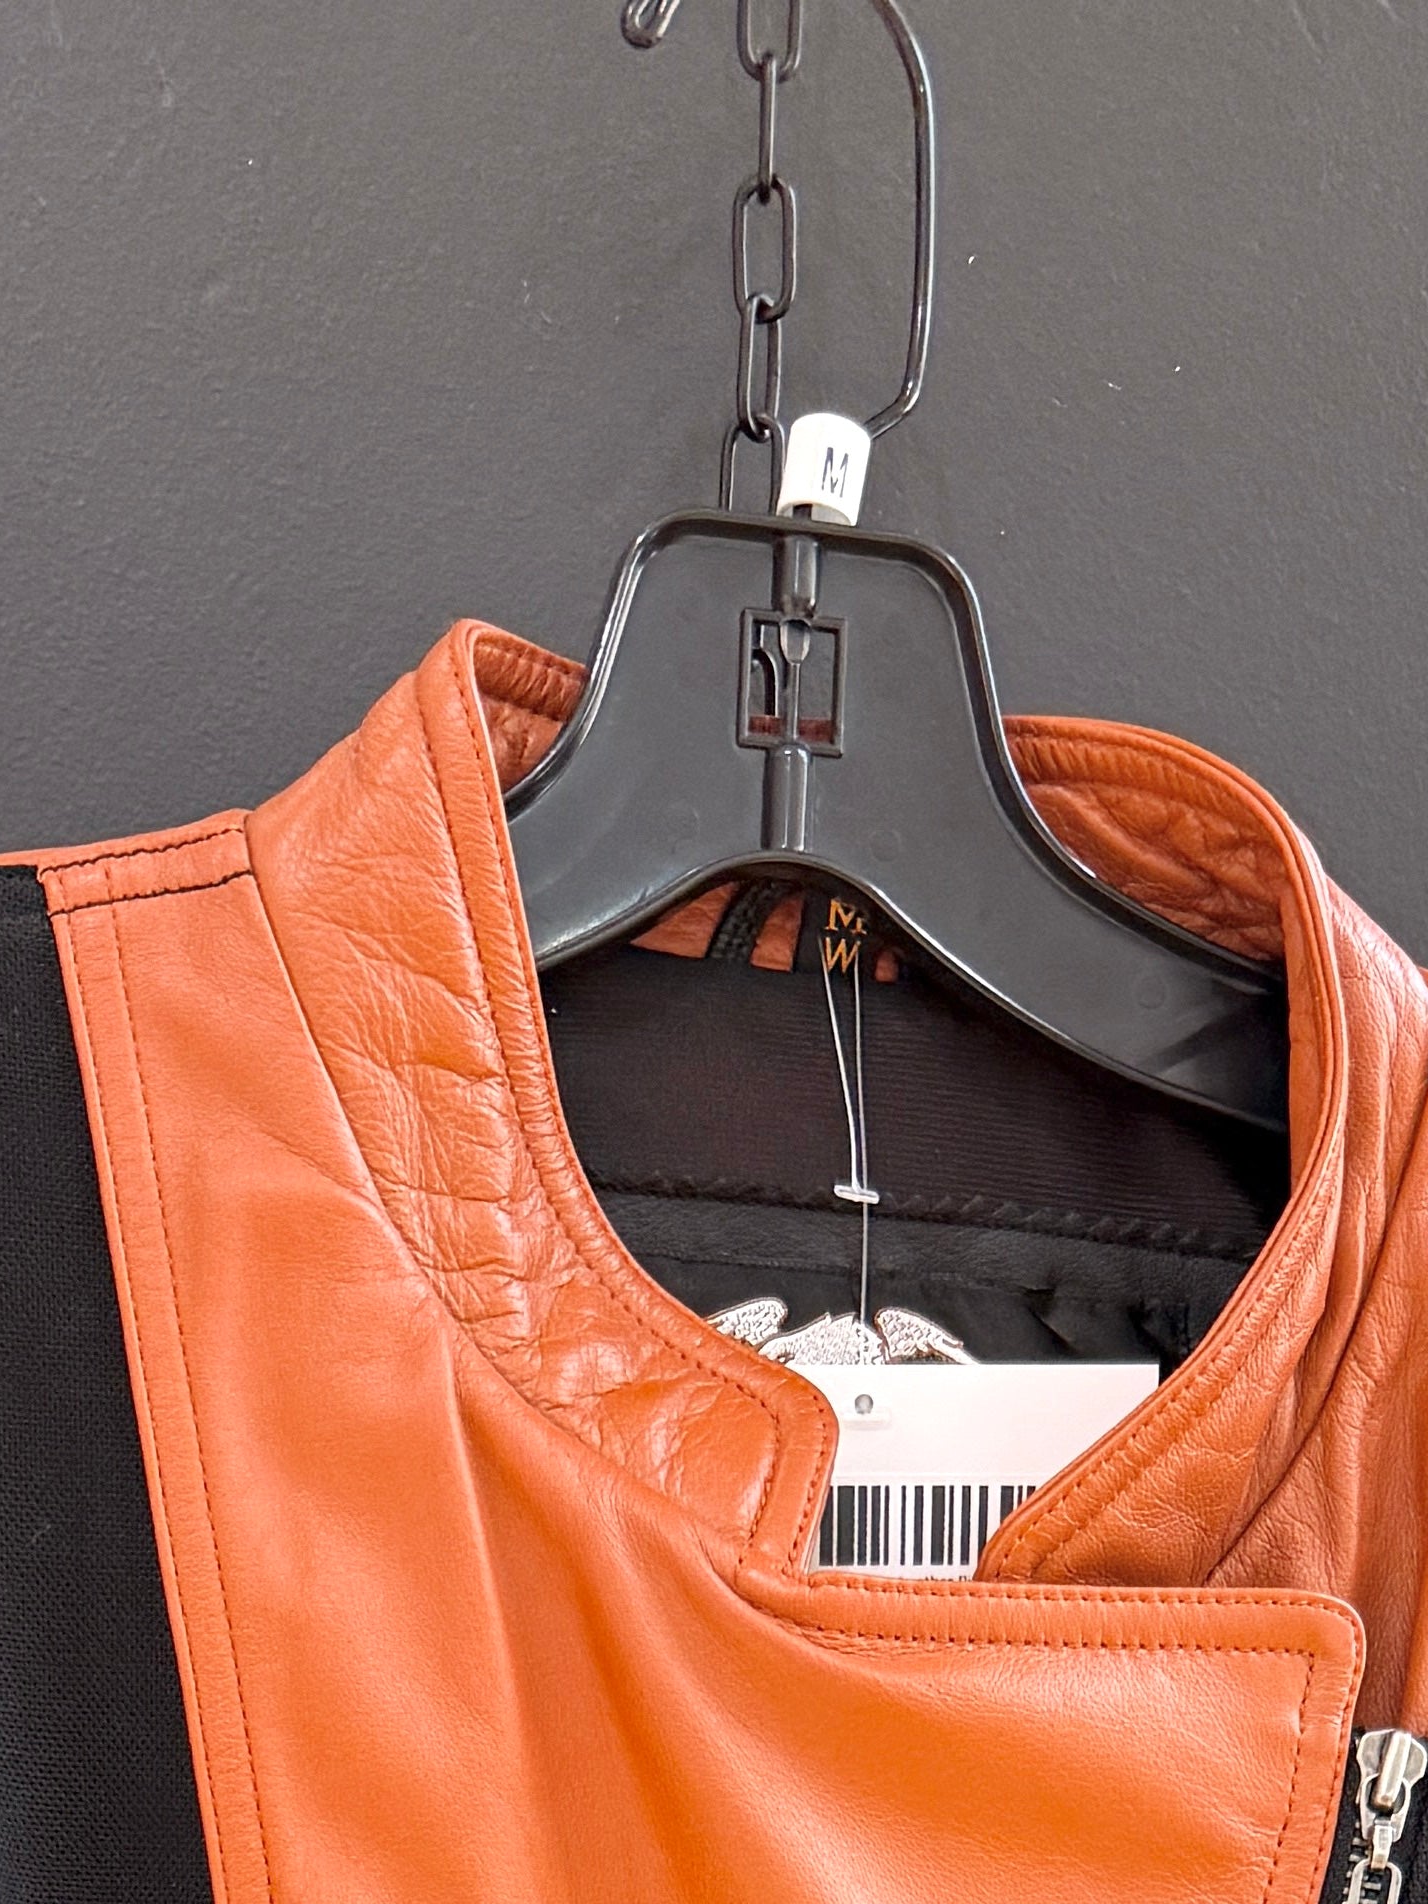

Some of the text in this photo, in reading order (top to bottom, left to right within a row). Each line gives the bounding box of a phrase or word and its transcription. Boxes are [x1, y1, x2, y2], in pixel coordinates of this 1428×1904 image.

[820, 446, 850, 499] M
[823, 897, 868, 935] M
[823, 936, 862, 975] W
